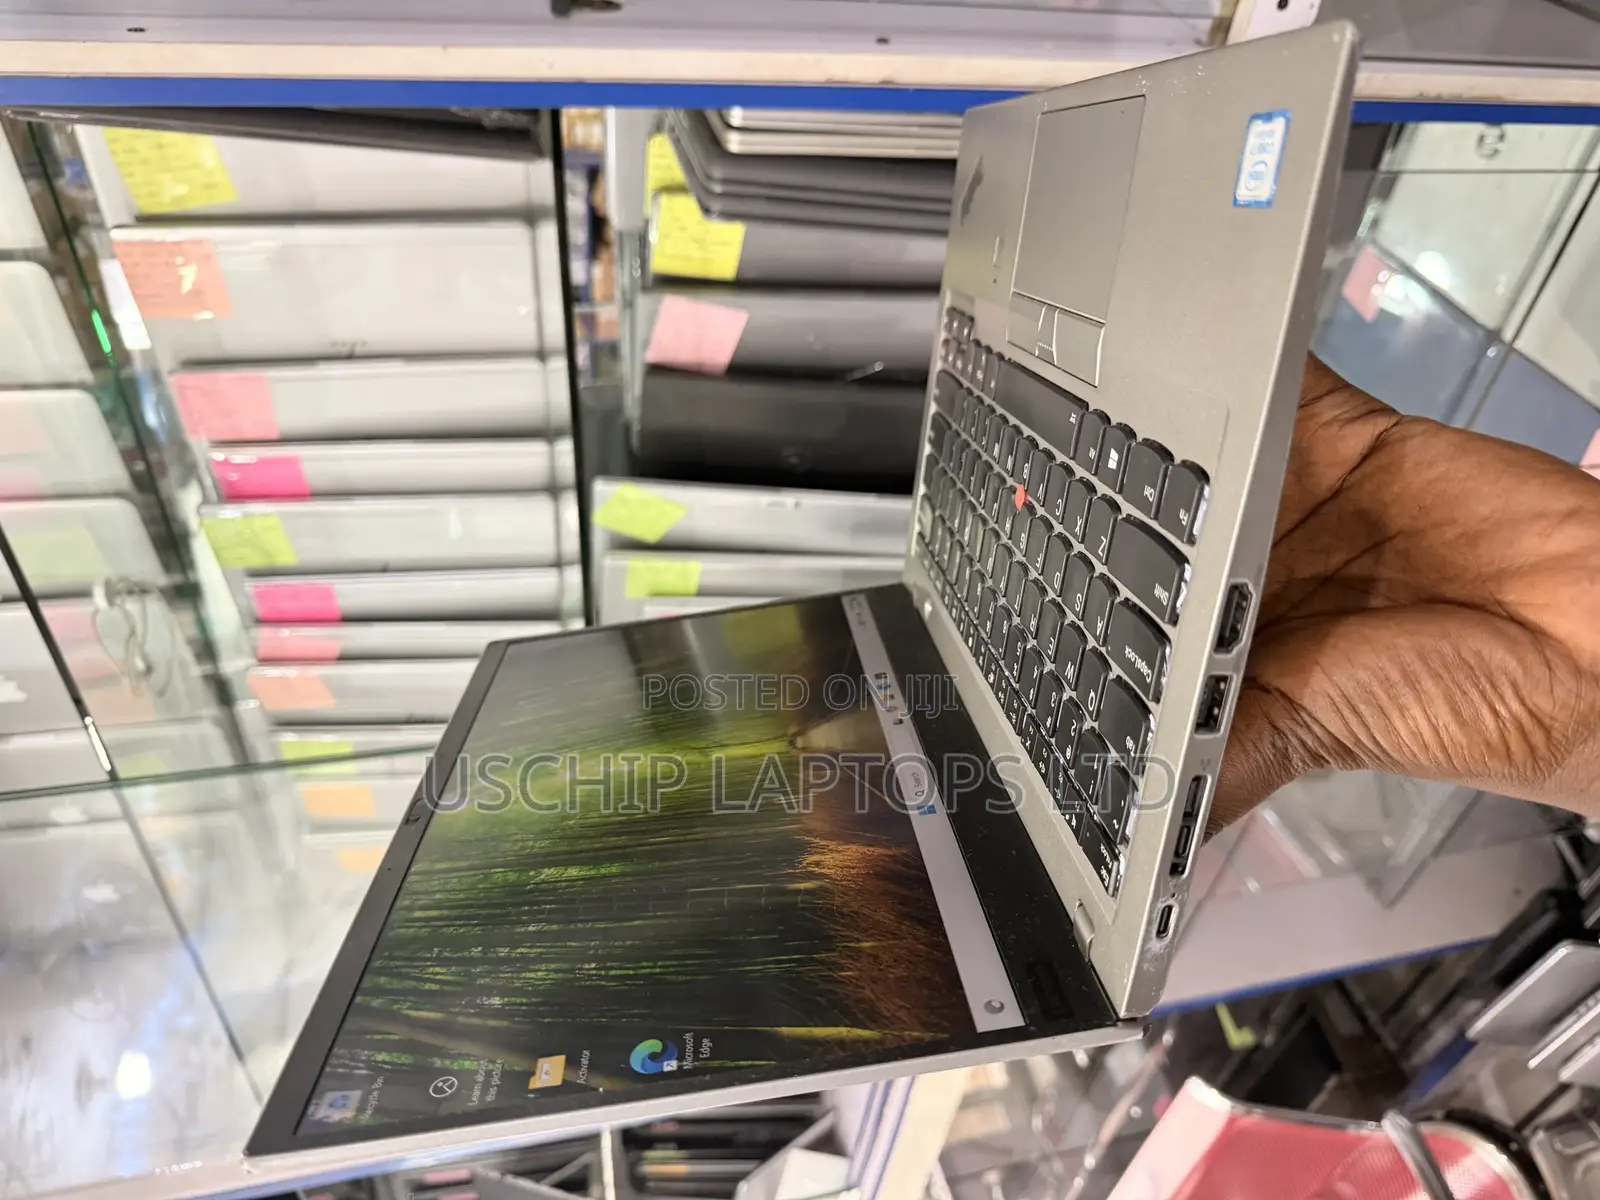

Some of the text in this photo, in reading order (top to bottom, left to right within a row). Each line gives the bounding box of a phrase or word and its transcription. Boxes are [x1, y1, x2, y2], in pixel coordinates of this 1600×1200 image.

[1023, 463, 1029, 479] B
[1037, 483, 1043, 499] V
[1143, 485, 1155, 502] Ctrl
[1056, 499, 1062, 516] C
[1075, 516, 1082, 535] X
[1180, 508, 1188, 526] Fn
[1020, 533, 1025, 549] G
[1098, 536, 1106, 557] Z
[1036, 553, 1042, 568] F
[1054, 572, 1060, 589] D
[1015, 594, 1020, 610] T
[1075, 593, 1082, 611] S
[1154, 583, 1169, 606] Shift
[1030, 614, 1037, 631] R
[1097, 616, 1103, 636] A
[1048, 637, 1054, 655] E
[1033, 665, 1037, 678] 4
[1065, 661, 1074, 683] W
[1125, 645, 1152, 683] CapsLock
[1051, 692, 1056, 707] 3
[1088, 689, 1095, 711] Q
[1071, 719, 1077, 736] 2
[1126, 736, 1136, 757] Tab
[910, 771, 923, 788] Search
[1100, 865, 1109, 887] Esc
[683, 1032, 694, 1070] Microsoft
[699, 1037, 712, 1058] Edge
[576, 1049, 591, 1084] Activator
[467, 1082, 482, 1106] Learn
[485, 1086, 497, 1102] this
